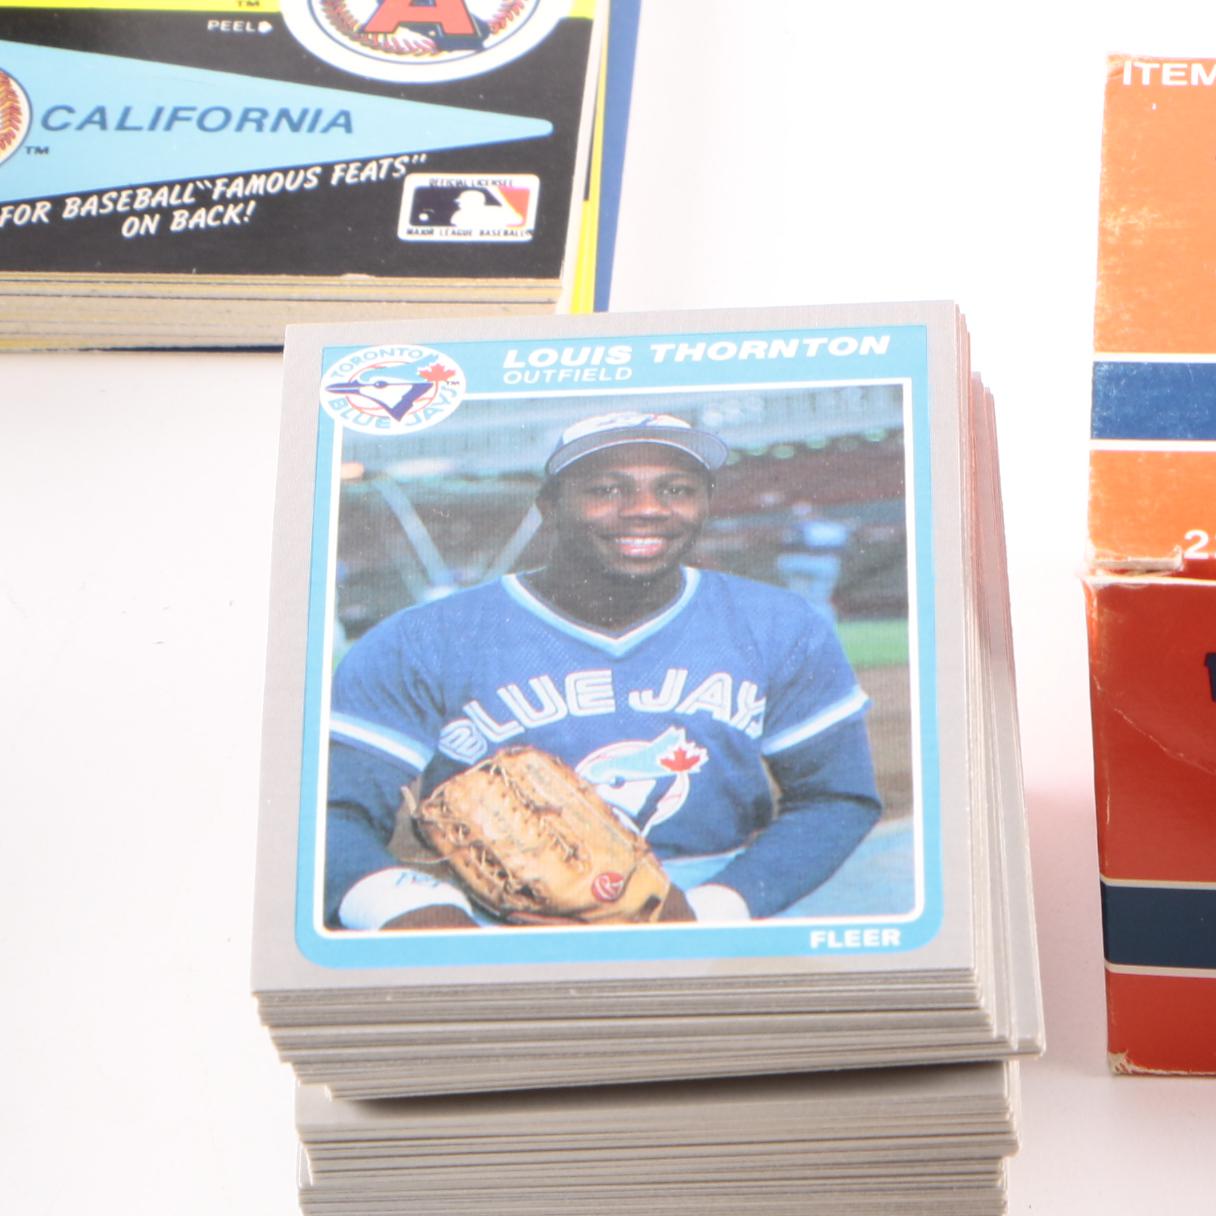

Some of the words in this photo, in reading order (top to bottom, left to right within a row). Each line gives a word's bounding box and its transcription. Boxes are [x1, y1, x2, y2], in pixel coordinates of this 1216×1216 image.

[206, 19, 257, 33] PEEL
[40, 103, 354, 135] CALIFORNIA
[0, 201, 52, 228] FOR
[121, 213, 160, 239] ON
[169, 199, 257, 232] BACK!
[331, 347, 424, 379] TORONTO
[502, 345, 632, 370] LOUIS
[649, 335, 892, 364] THORNTON
[502, 366, 633, 386] OUTFIELD
[327, 397, 391, 429] BLUE
[809, 928, 901, 949] FLEER
